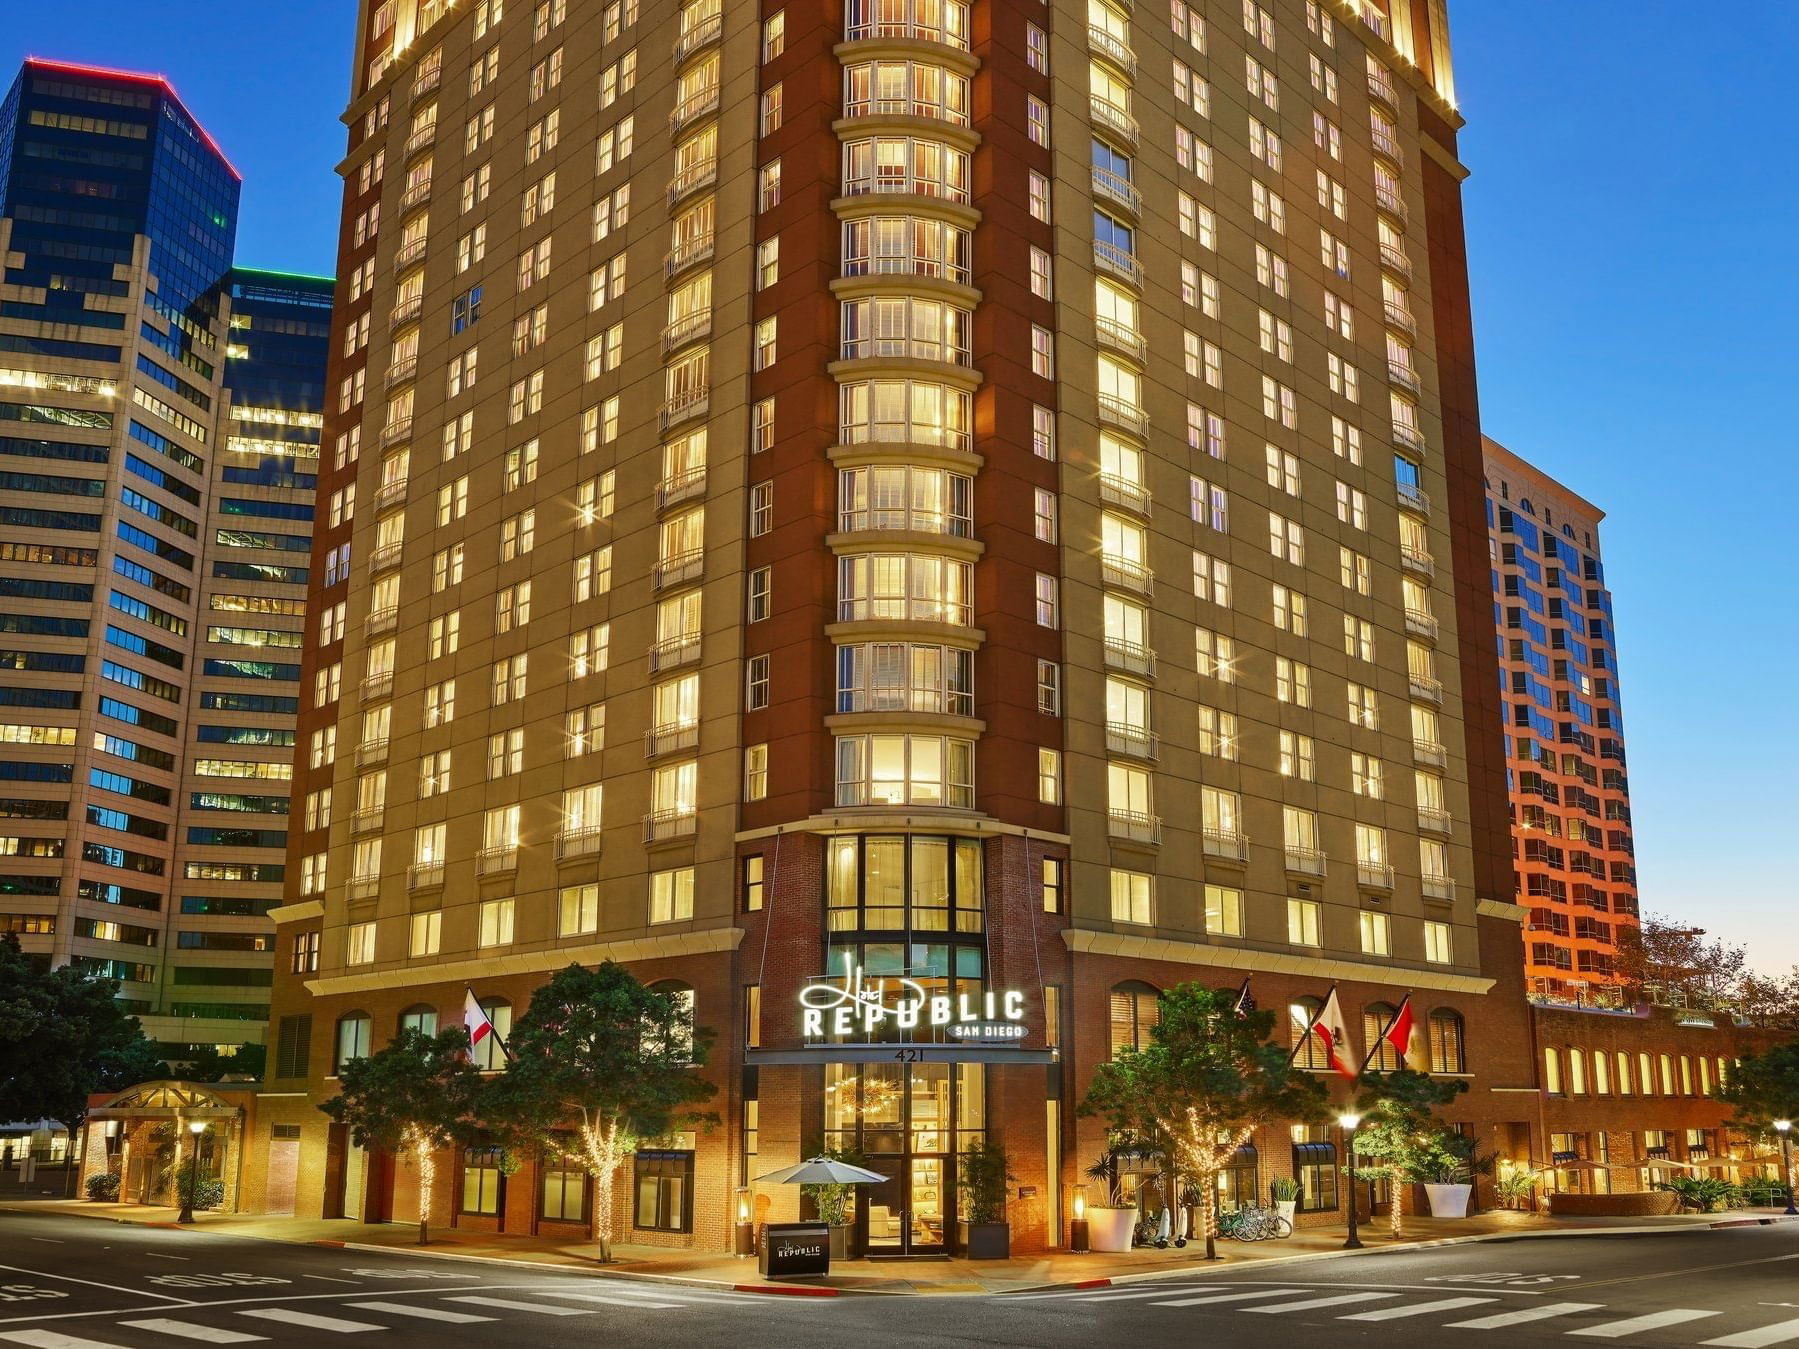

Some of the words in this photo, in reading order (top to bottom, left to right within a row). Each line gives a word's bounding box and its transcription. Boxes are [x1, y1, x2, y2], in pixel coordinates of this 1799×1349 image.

[803, 990, 1024, 1037] REPUBLIC
[955, 1025, 980, 1037] SAN
[984, 1025, 1022, 1037] DIEGO
[895, 1050, 924, 1063] 421
